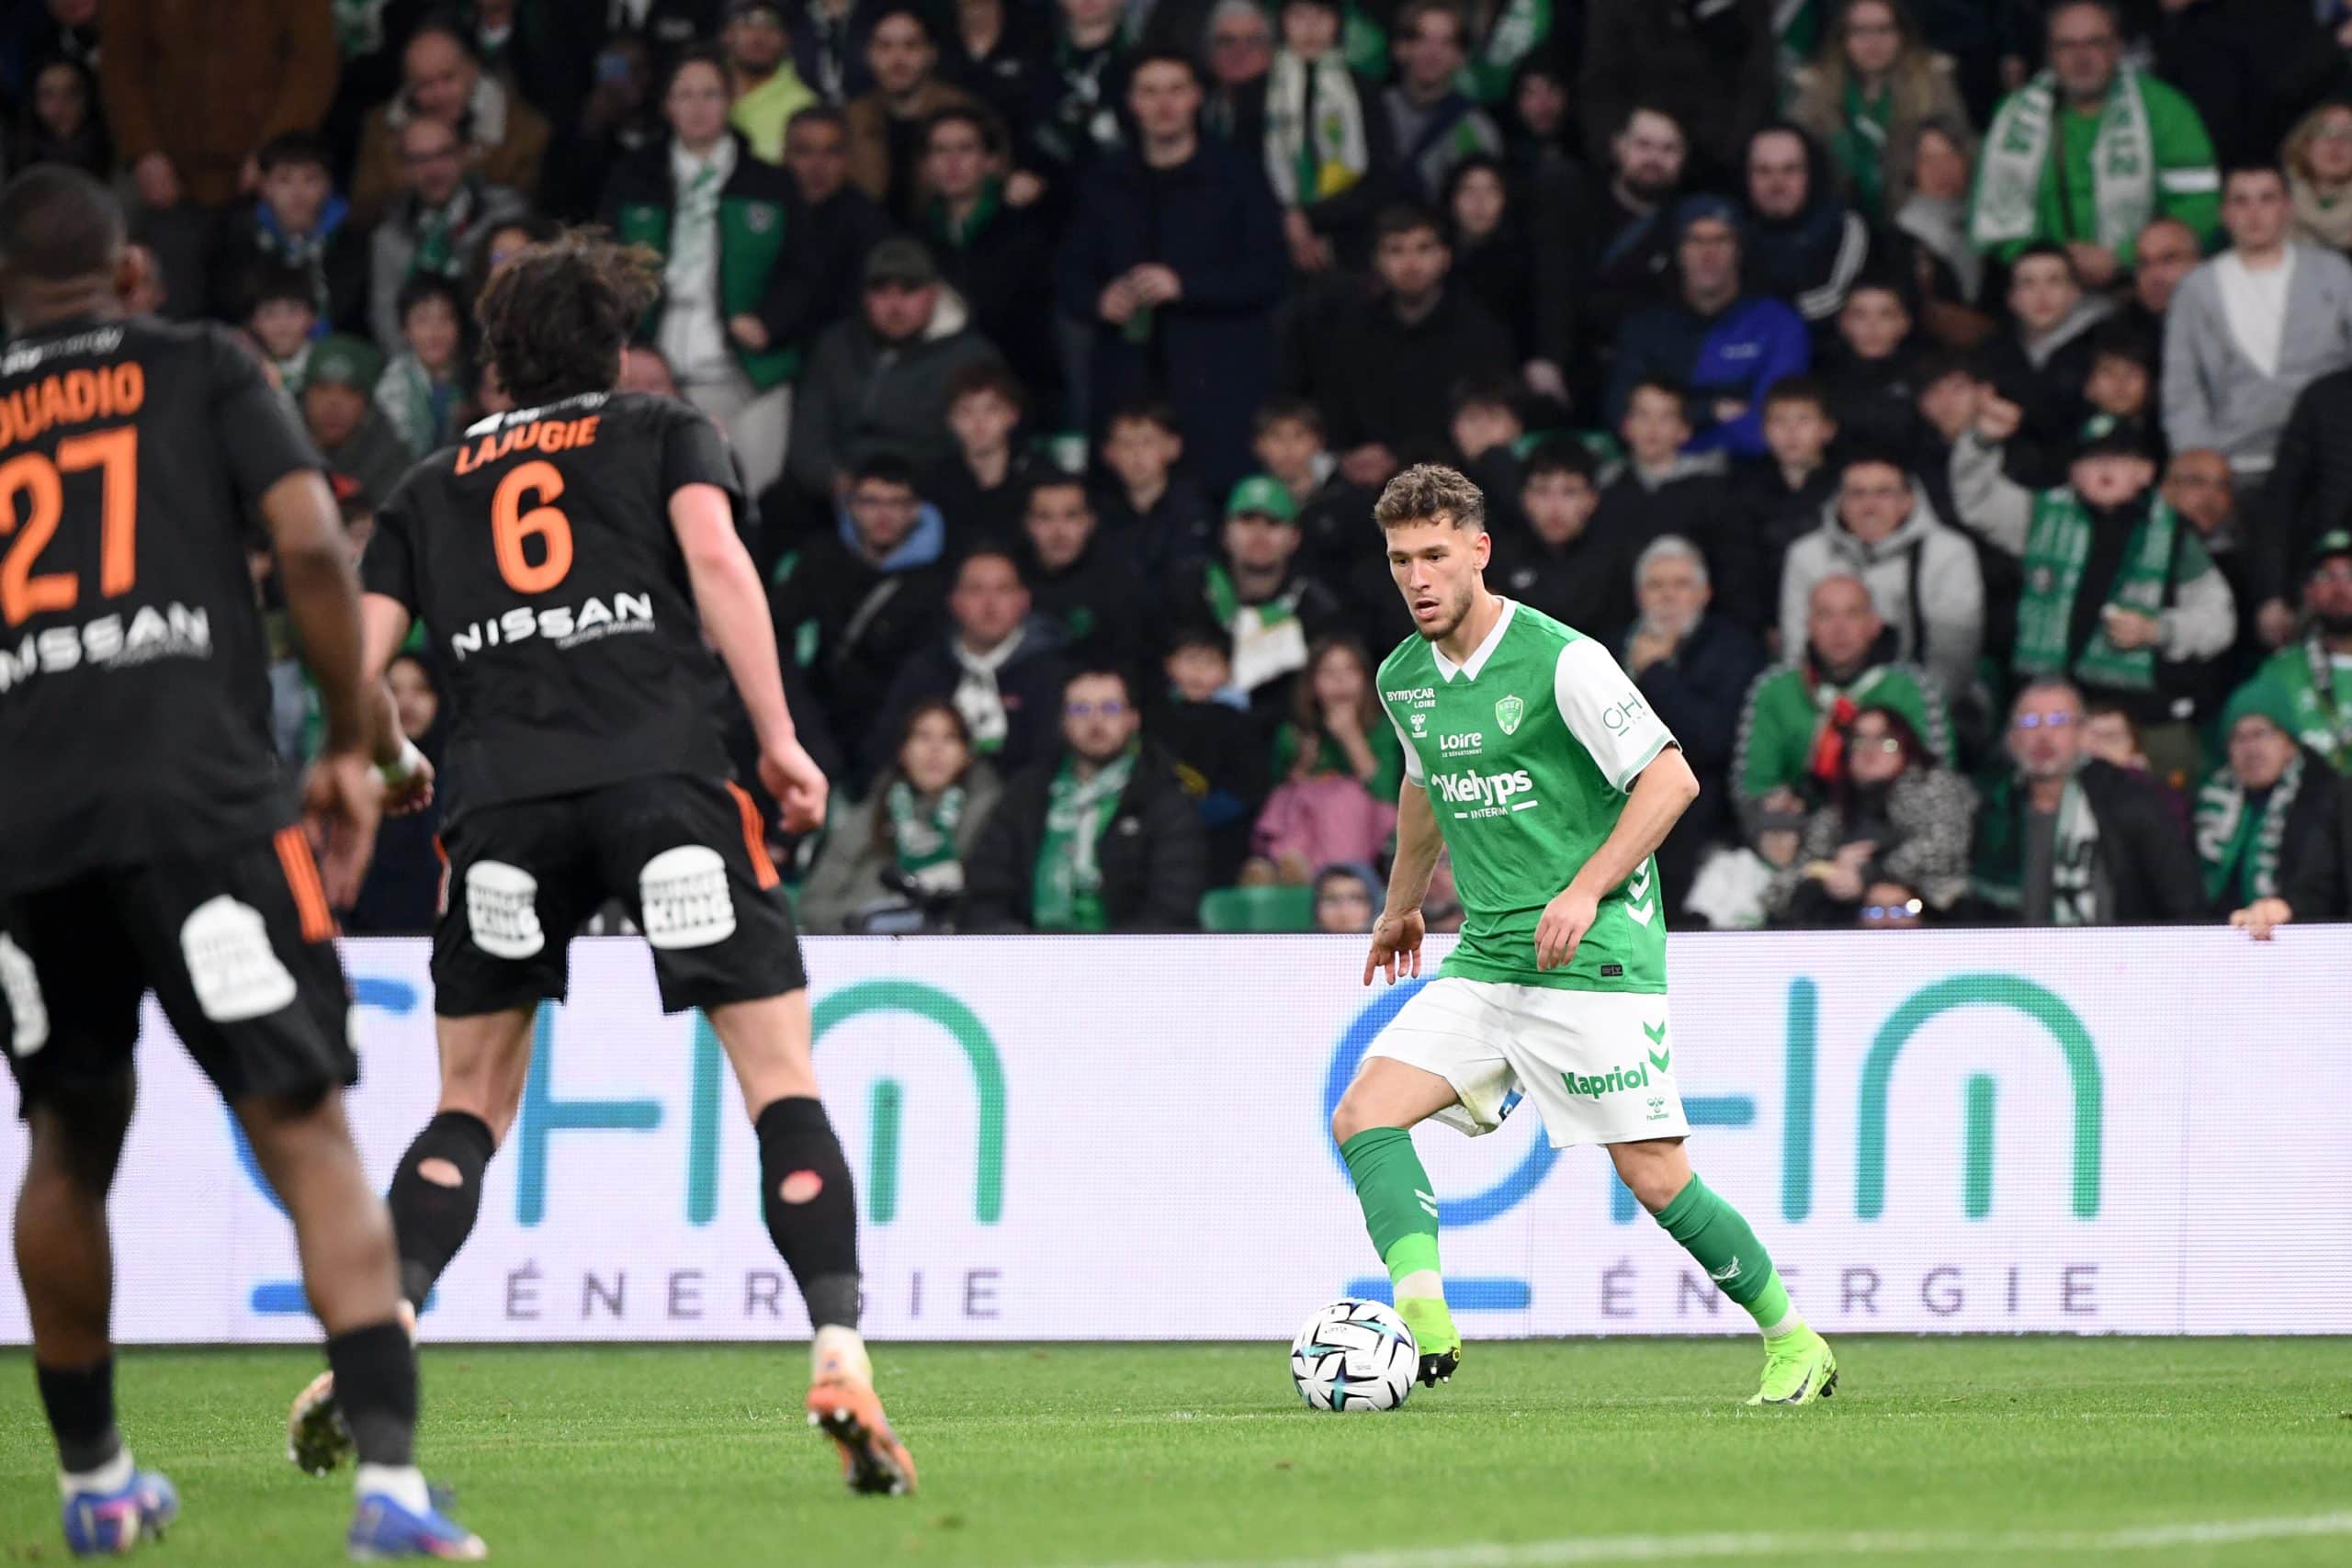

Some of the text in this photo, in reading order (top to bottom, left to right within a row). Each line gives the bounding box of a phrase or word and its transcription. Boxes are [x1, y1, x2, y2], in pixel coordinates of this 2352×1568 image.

[454, 414, 601, 475] LAJUGIE
[0, 424, 138, 627] 27
[491, 460, 573, 593] 6
[451, 592, 653, 660] NISSAN
[1440, 732, 1482, 750] Loire
[1431, 769, 1533, 807] Kelyps
[1561, 1062, 1649, 1099] Kapriol
[504, 1258, 1002, 1319] ÉNERIE
[1600, 1256, 2100, 1316] ÉNRGIE
